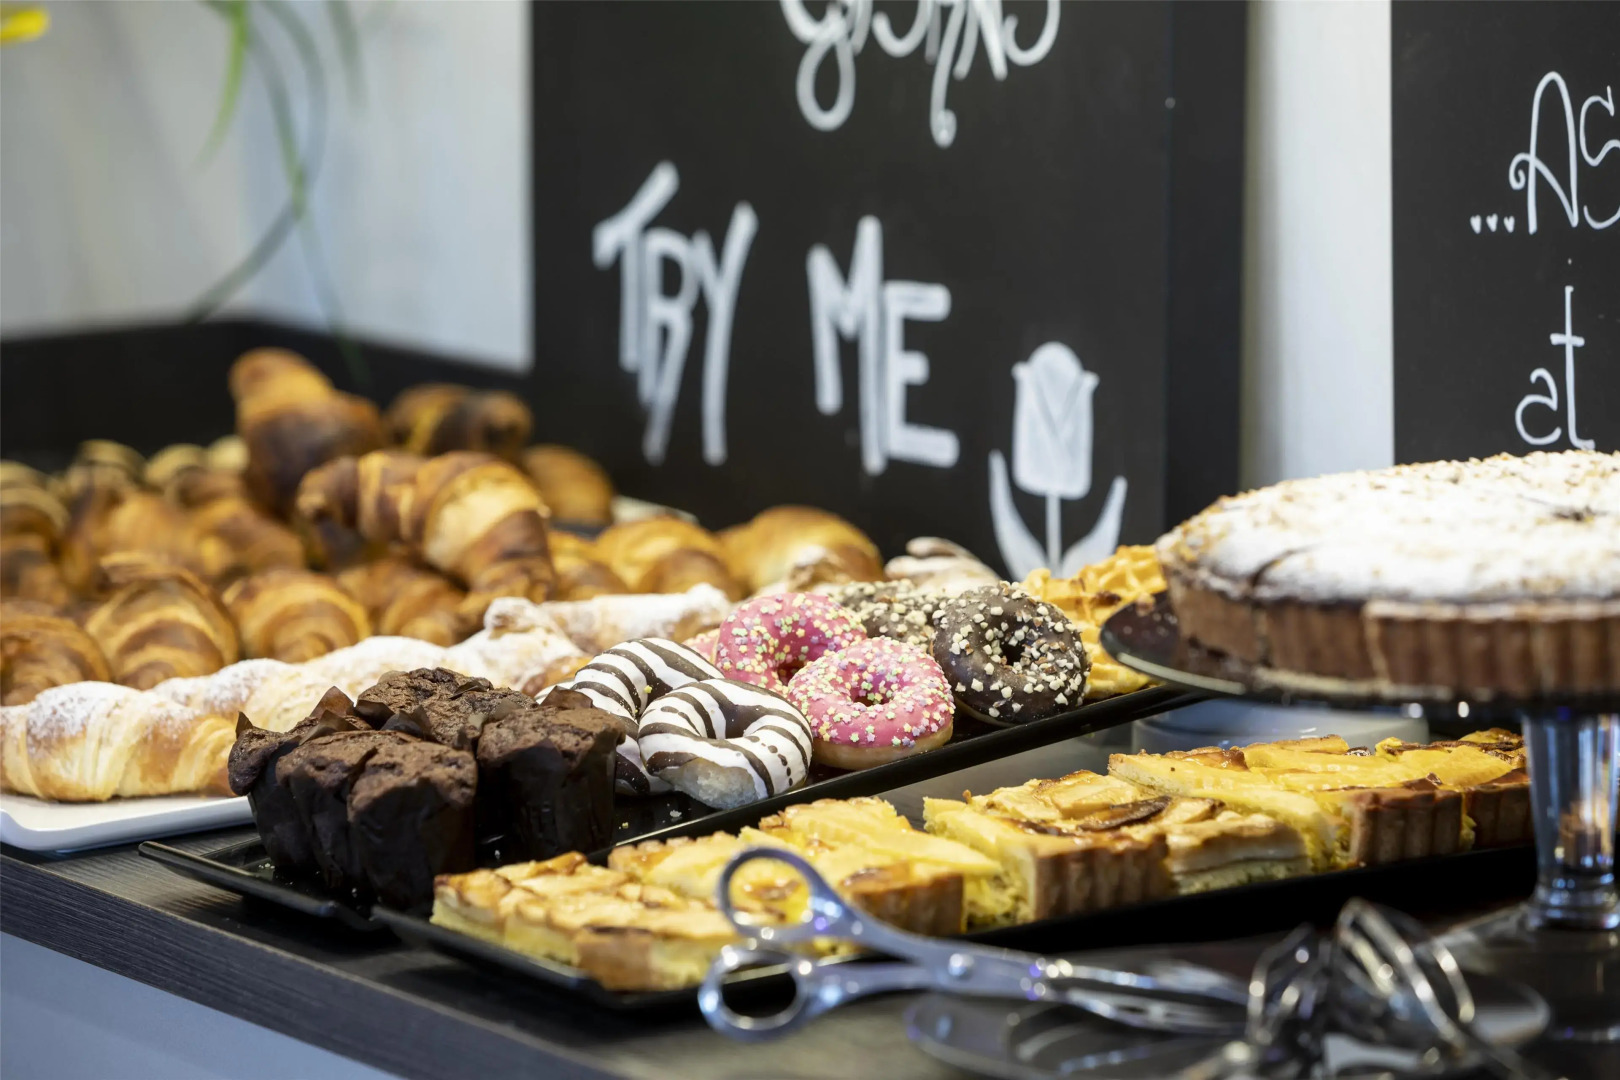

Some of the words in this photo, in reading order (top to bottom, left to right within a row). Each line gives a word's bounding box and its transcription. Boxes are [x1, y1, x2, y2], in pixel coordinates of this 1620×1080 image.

[593, 160, 758, 465] TRY
[807, 215, 960, 475] ME
[1515, 286, 1596, 450] at
